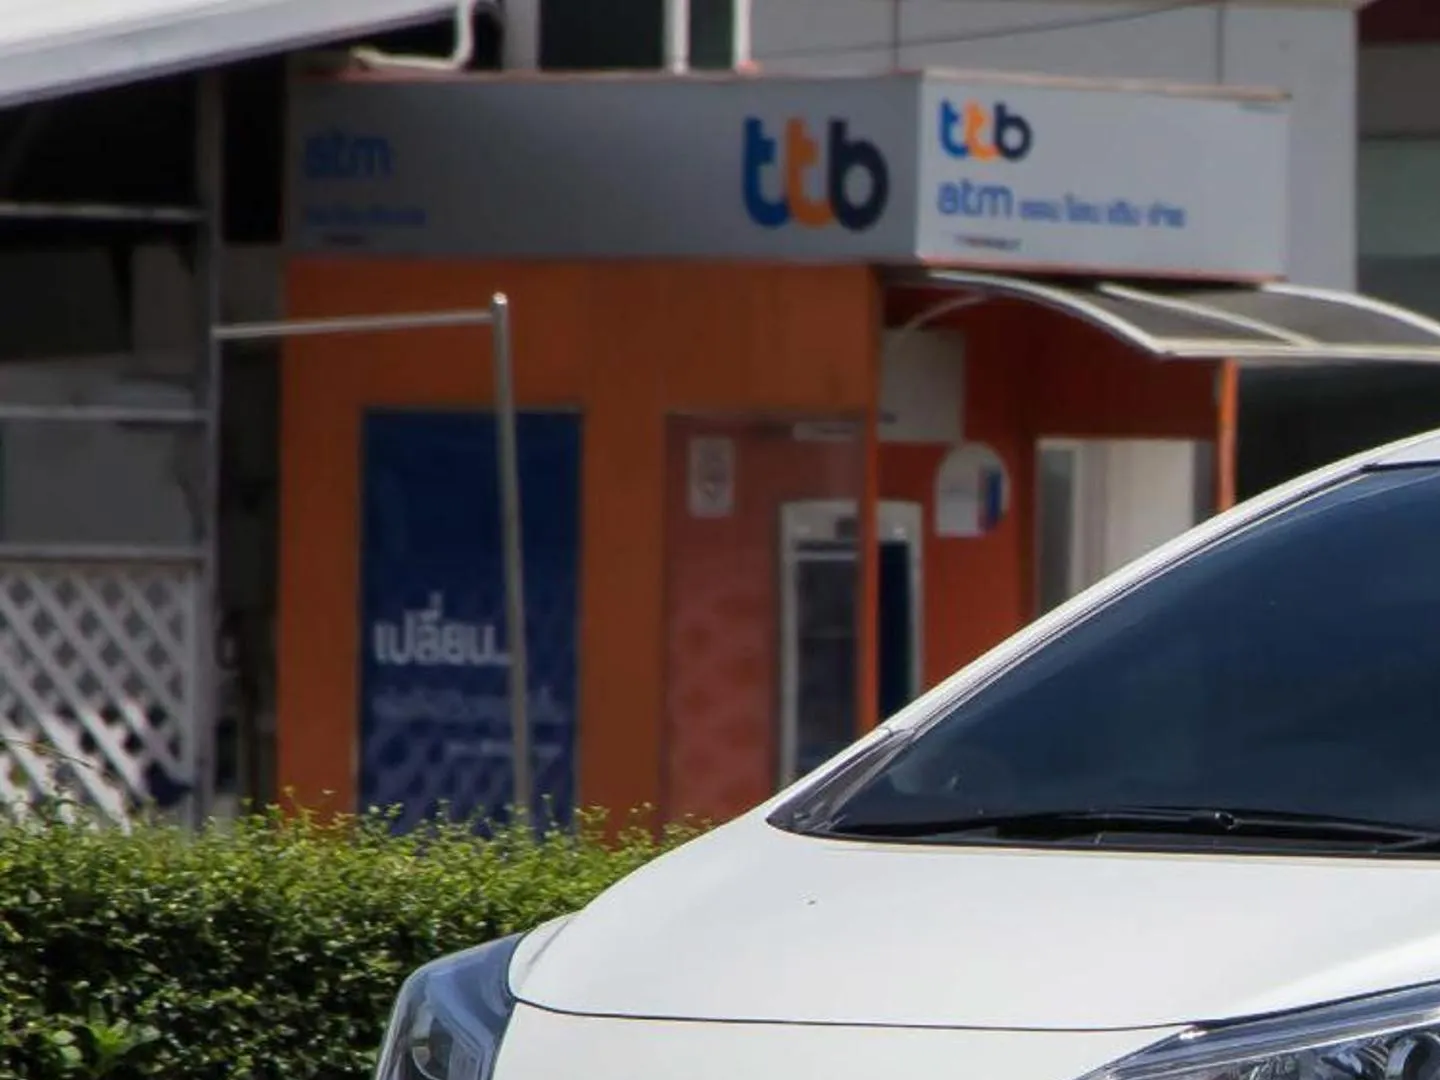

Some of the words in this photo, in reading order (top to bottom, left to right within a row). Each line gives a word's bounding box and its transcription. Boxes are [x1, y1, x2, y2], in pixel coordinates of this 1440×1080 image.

[937, 97, 1033, 162] ttb
[740, 116, 890, 230] ttb
[937, 178, 1014, 218] atm
